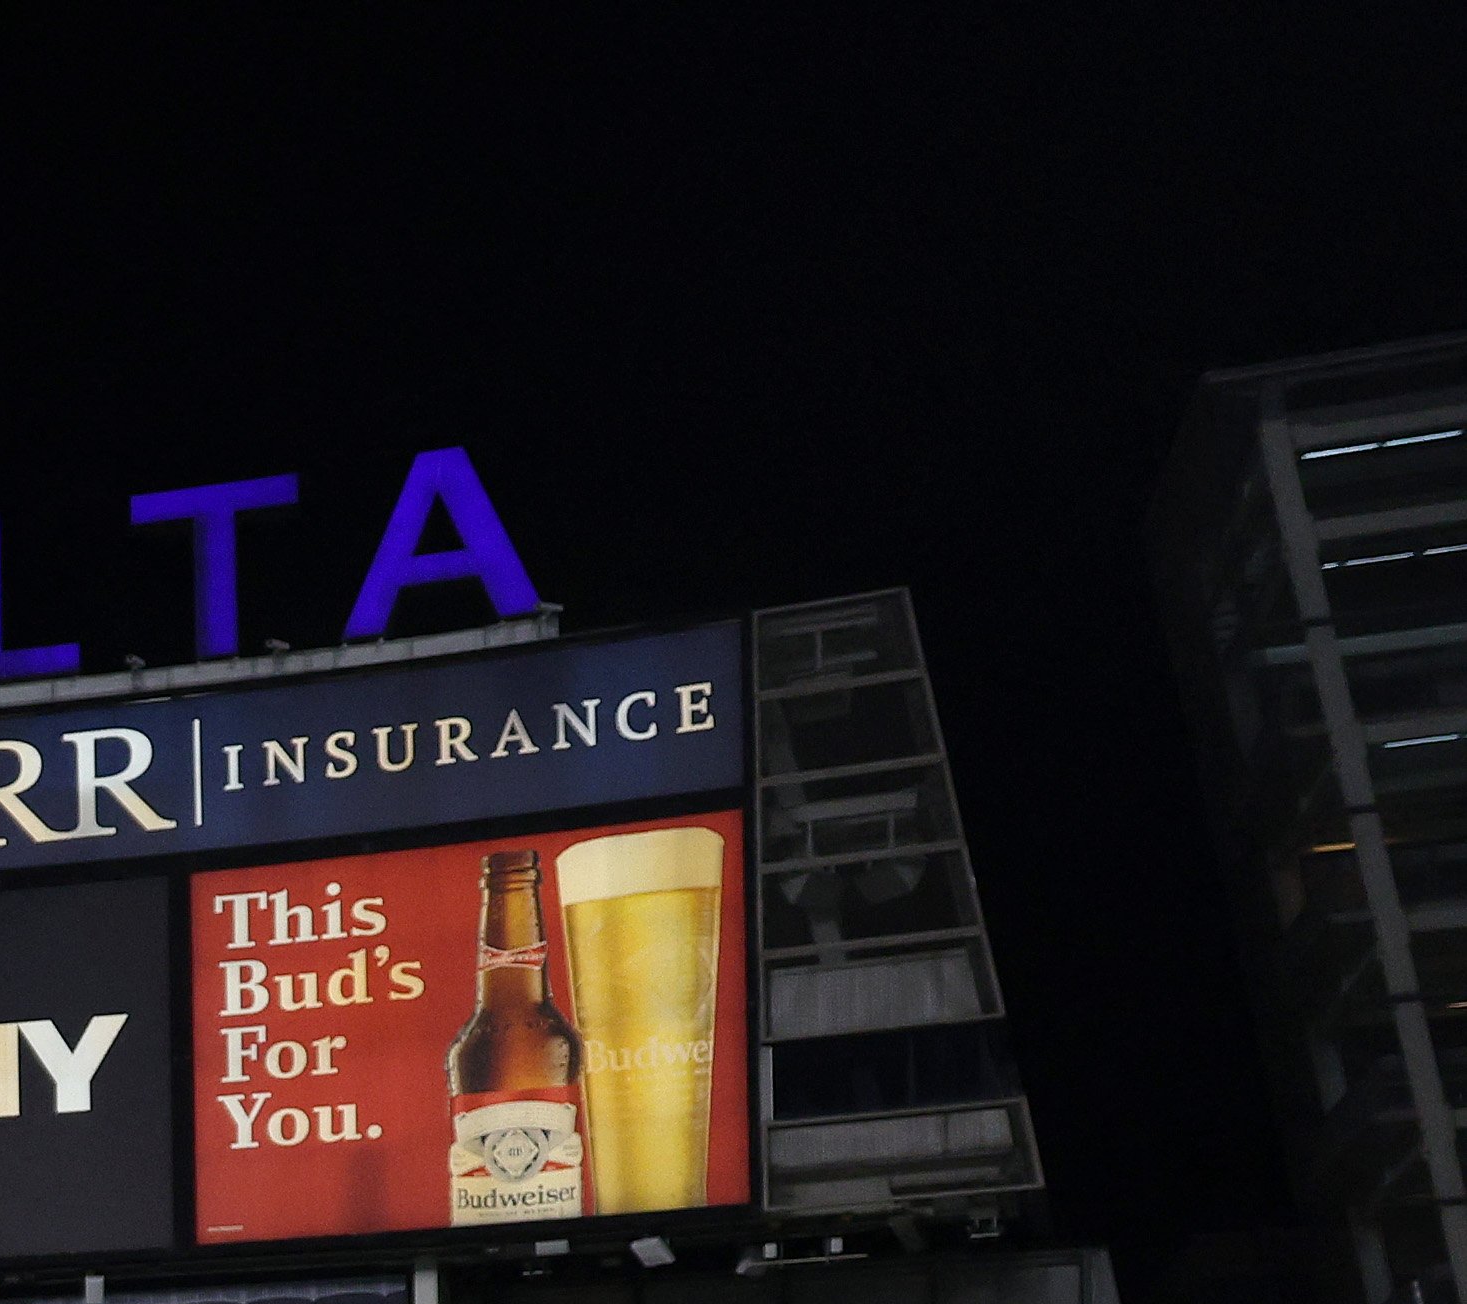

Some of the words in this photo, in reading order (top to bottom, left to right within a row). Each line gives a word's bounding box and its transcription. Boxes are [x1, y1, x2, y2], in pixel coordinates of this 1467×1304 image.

[222, 680, 717, 792] INSURANCE
[214, 882, 387, 950] This
[218, 945, 427, 1019] Bud's
[219, 1024, 347, 1083] For
[218, 1092, 384, 1149] You.
[456, 1182, 578, 1211] Budweiser
